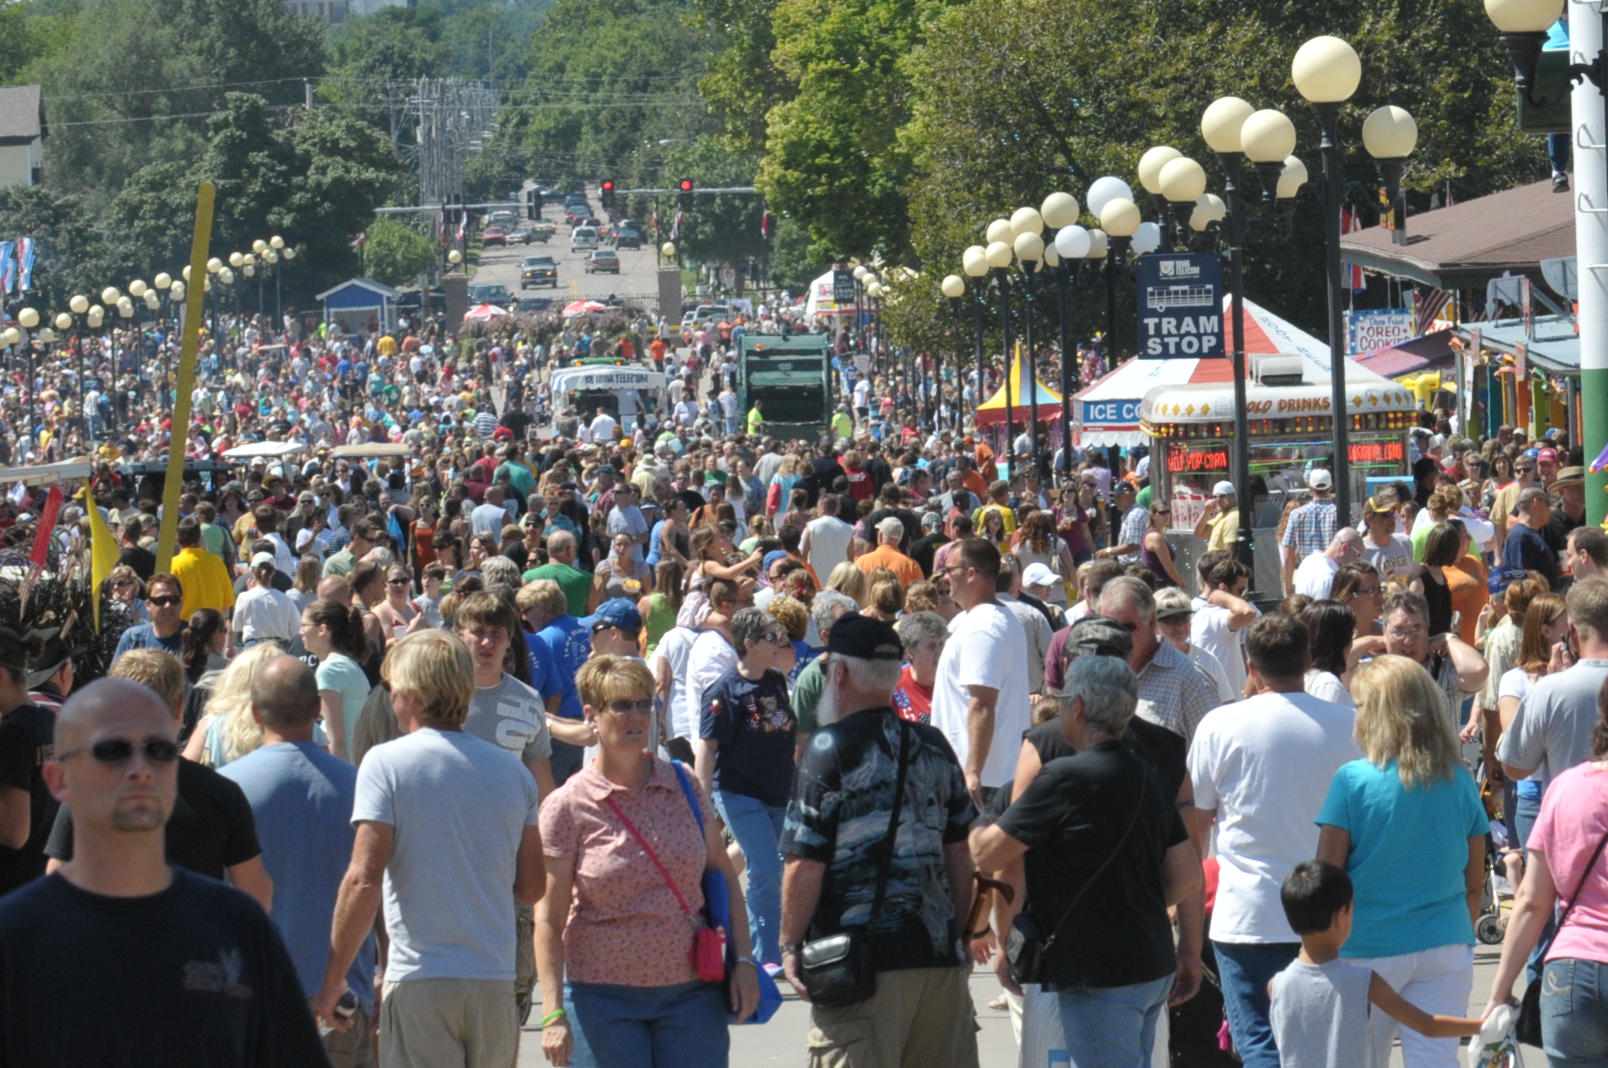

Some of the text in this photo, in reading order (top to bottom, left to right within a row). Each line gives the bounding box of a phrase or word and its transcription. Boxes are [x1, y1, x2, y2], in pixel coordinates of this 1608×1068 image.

[1143, 315, 1219, 336] TRAM
[1366, 326, 1401, 338] OREO
[1147, 335, 1217, 355] STOP
[1089, 403, 1118, 420] ICE
[1246, 396, 1331, 414] OLD DRINKS
